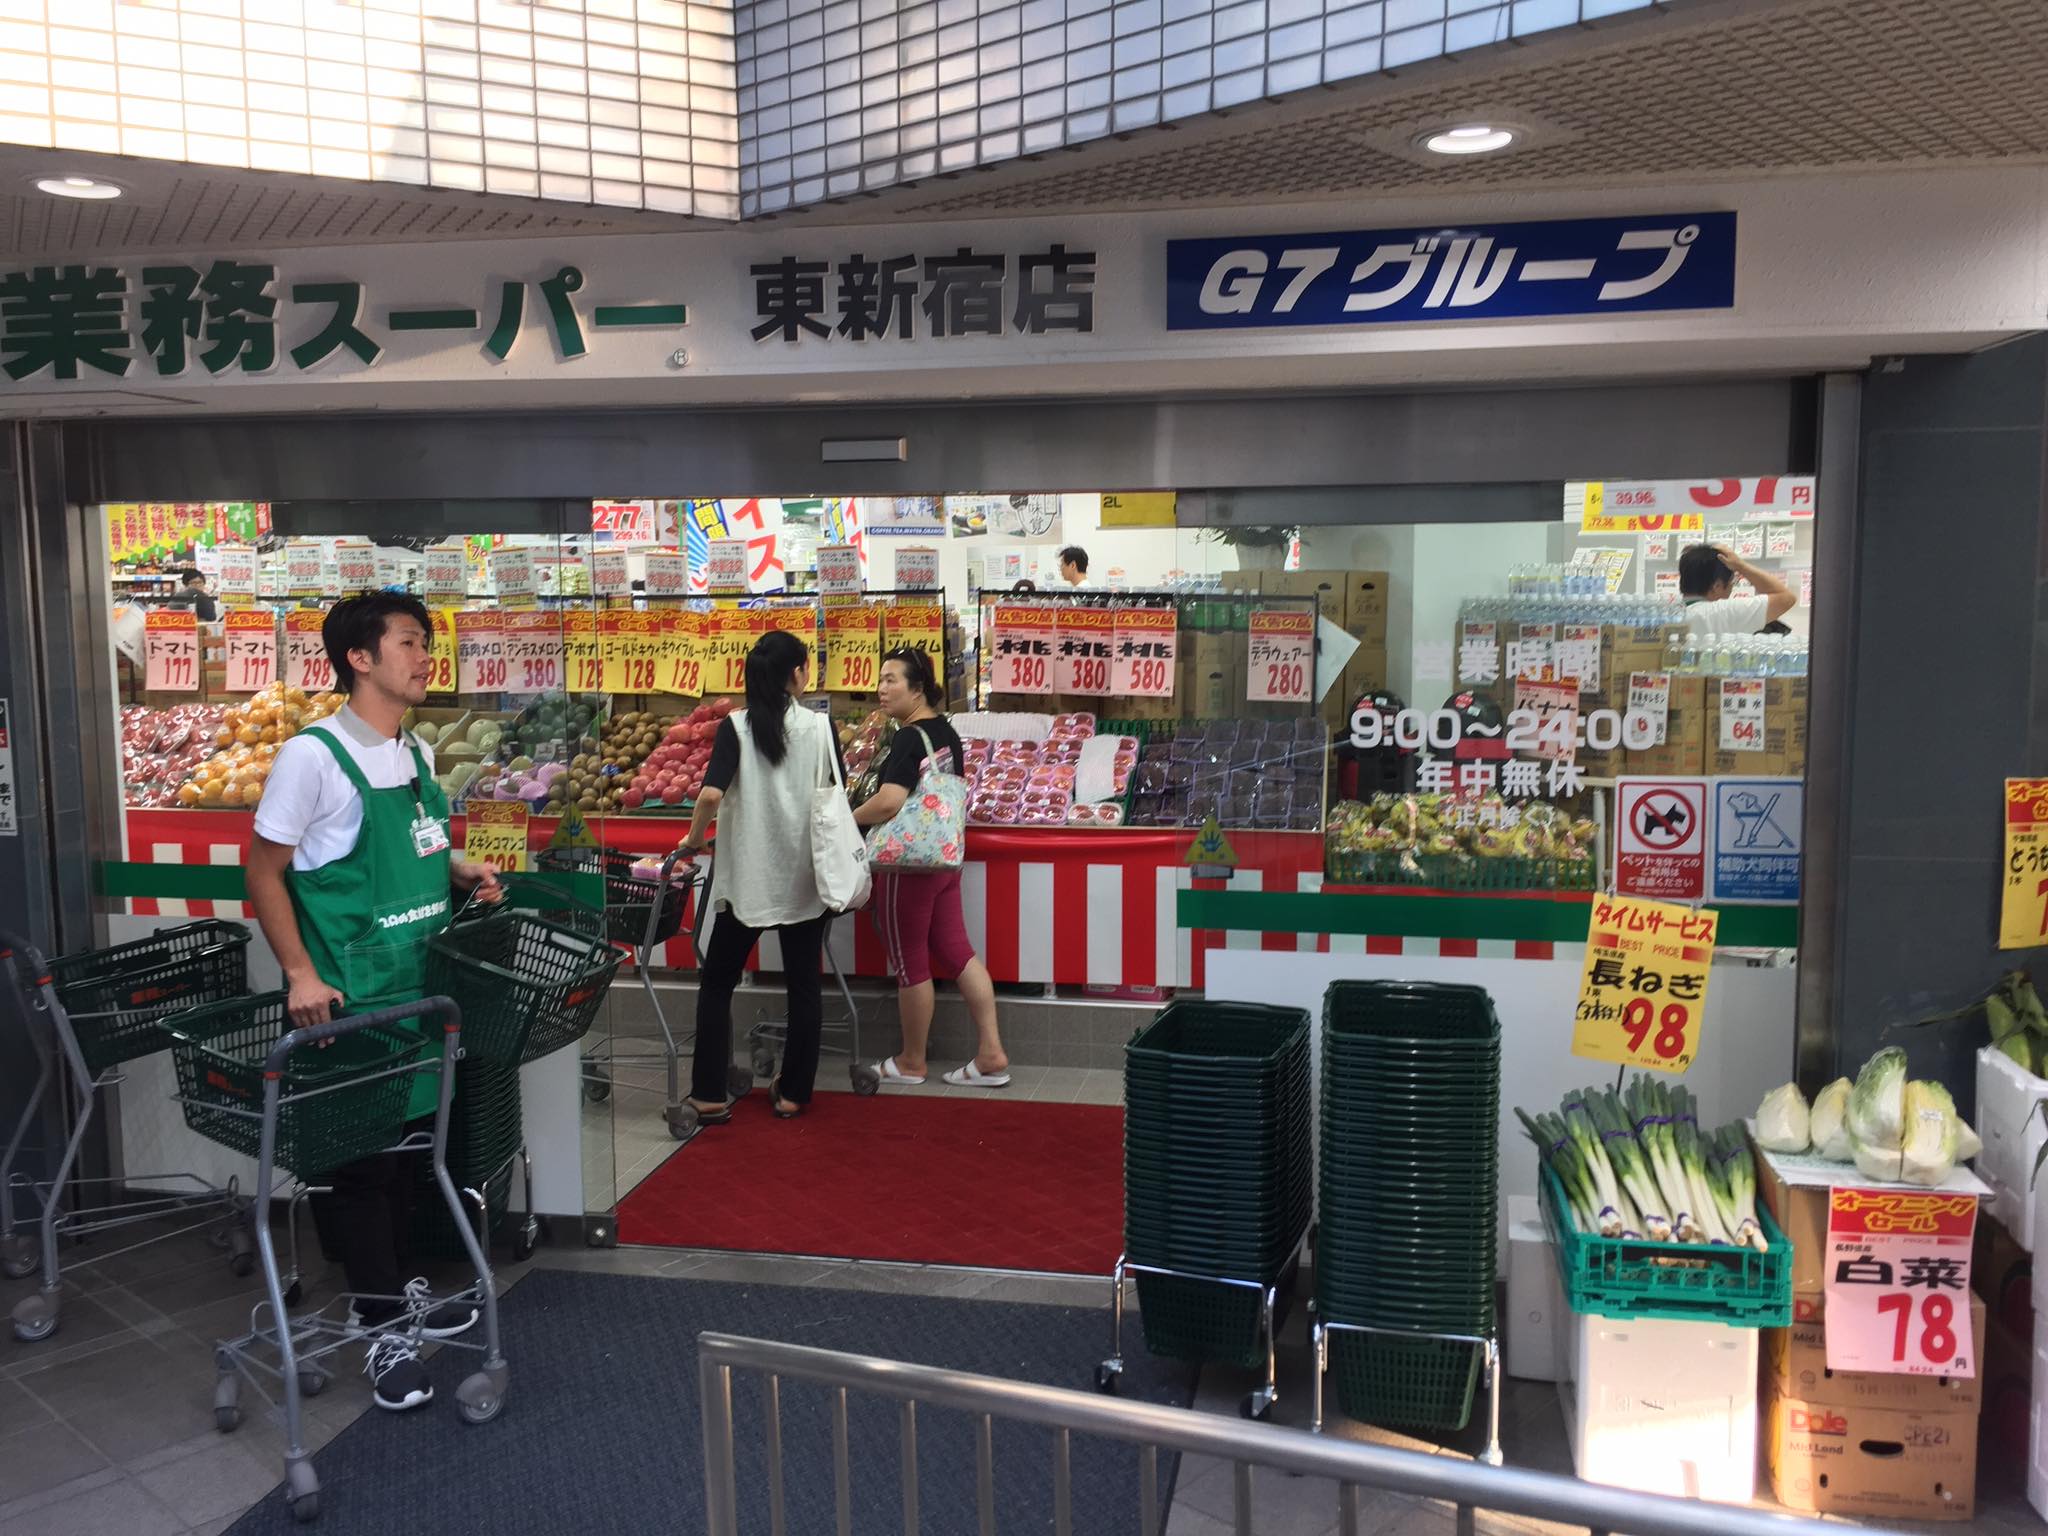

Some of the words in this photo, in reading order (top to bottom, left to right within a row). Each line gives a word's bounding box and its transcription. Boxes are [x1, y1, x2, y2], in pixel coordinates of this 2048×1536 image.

[749, 244, 1096, 342] 東新宿店
[1, 261, 686, 379] 業務スーパー
[592, 505, 641, 529] 277
[1103, 496, 1123, 508] 2L
[150, 641, 196, 656] トマト
[230, 641, 275, 656] トマト
[164, 657, 192, 686] 177
[243, 657, 270, 686] 177
[302, 657, 331, 688] 298
[476, 657, 507, 688] 380
[524, 657, 556, 688] 380
[624, 658, 655, 689] 128
[672, 657, 700, 691] 128
[842, 655, 872, 687] 380
[1011, 657, 1045, 688] 380
[1072, 659, 1106, 690] 380
[1130, 659, 1166, 691] 580
[1267, 663, 1304, 696] 280
[1733, 721, 1754, 740] 64
[1416, 757, 1588, 798] 年中無休
[1595, 902, 1714, 944] タイムサービス
[1619, 938, 1644, 952] BEST
[1588, 958, 1705, 1000] 長ねぎ
[1622, 997, 1689, 1060] 98
[1833, 1191, 1977, 1217] オープニング
[1865, 1212, 1939, 1232] セール
[1835, 1255, 1967, 1290] 白菜
[1878, 1292, 1958, 1365] 78
[1955, 1358, 1967, 1370] 円
[1790, 1410, 1848, 1432] Dole
